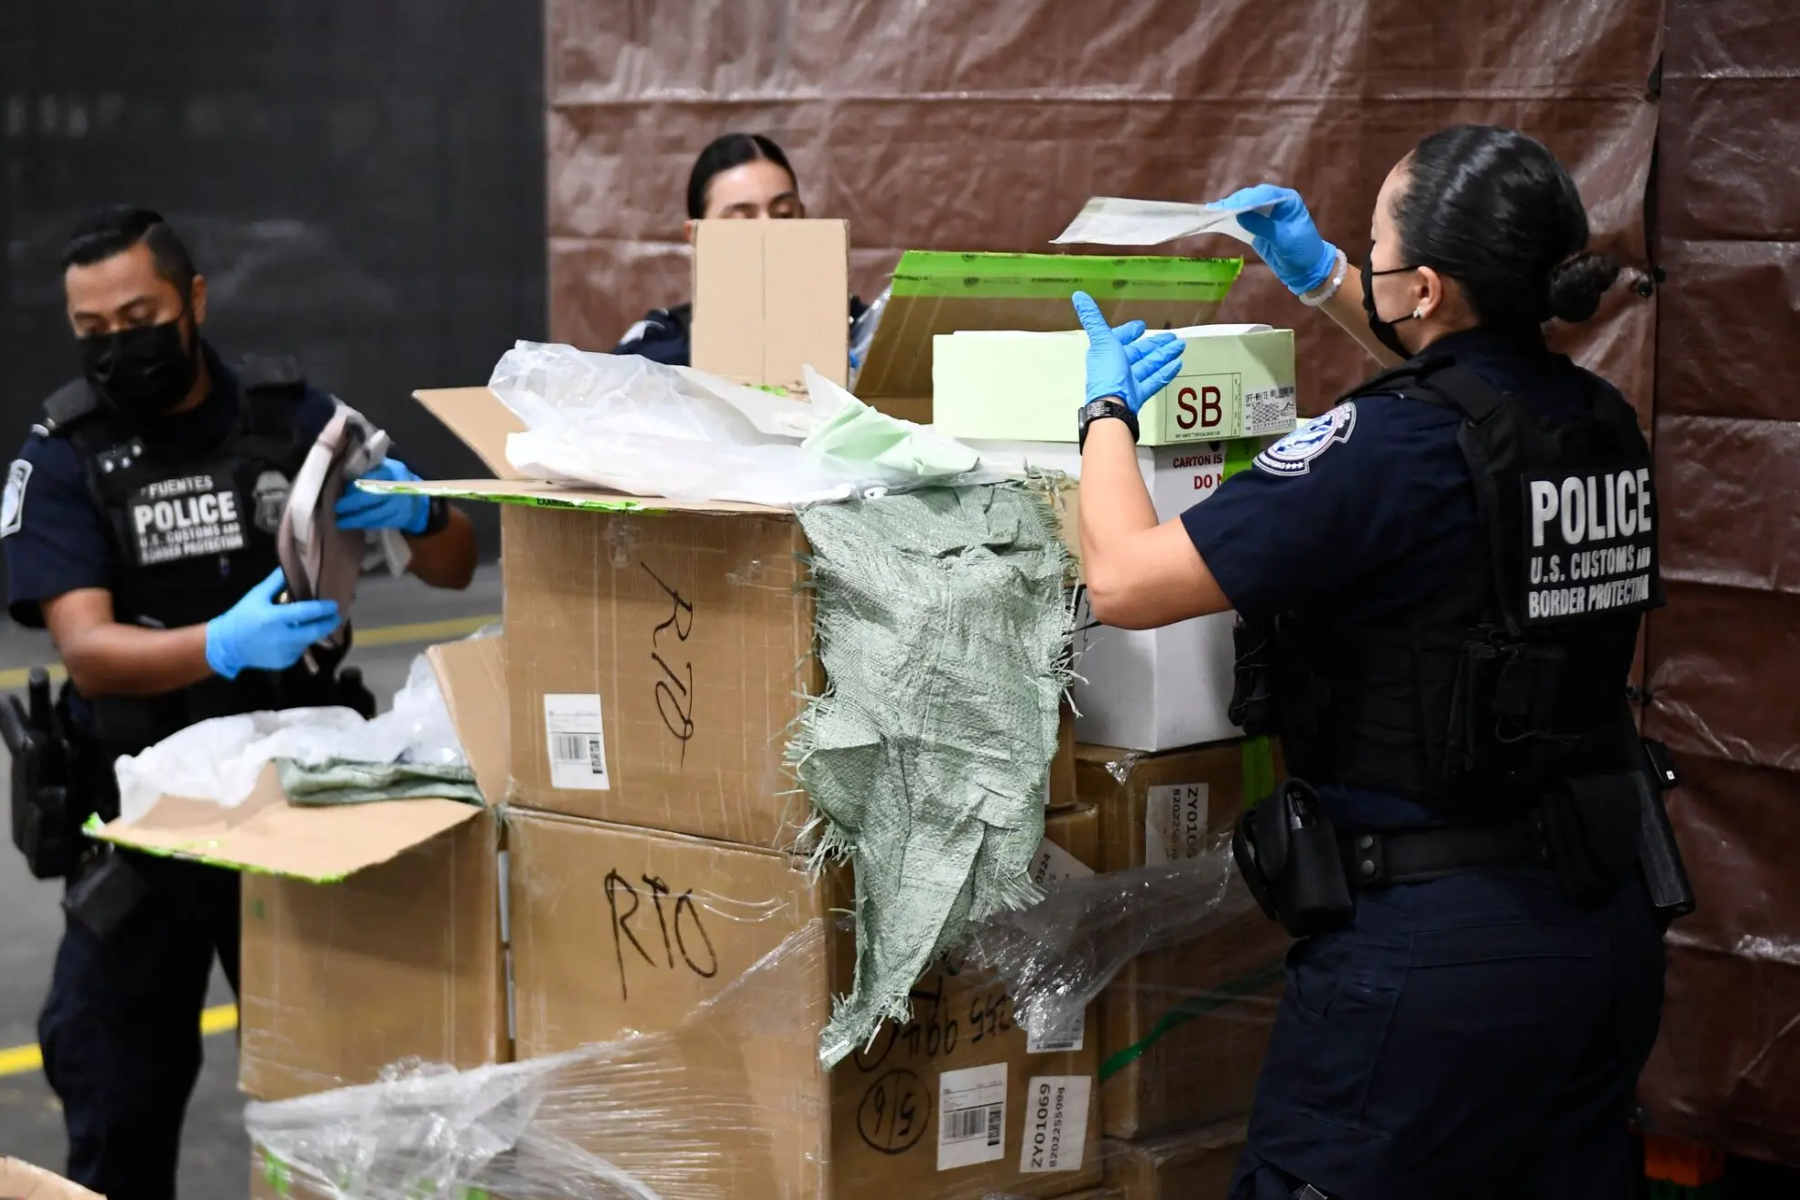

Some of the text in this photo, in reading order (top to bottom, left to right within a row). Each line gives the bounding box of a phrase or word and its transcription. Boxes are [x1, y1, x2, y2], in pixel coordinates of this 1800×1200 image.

[1177, 386, 1222, 429] SB
[1173, 453, 1223, 468] CARTON IS
[1194, 474, 1213, 489] DO
[149, 475, 213, 498] FUENTES
[1530, 468, 1652, 547] POLICE
[134, 491, 237, 534] POLICE
[1530, 554, 1566, 584] U.S.
[1570, 544, 1634, 581] CUSTOMS
[1529, 574, 1650, 619] BORDER PROTECTION
[1031, 1083, 1051, 1168] ZY01069
